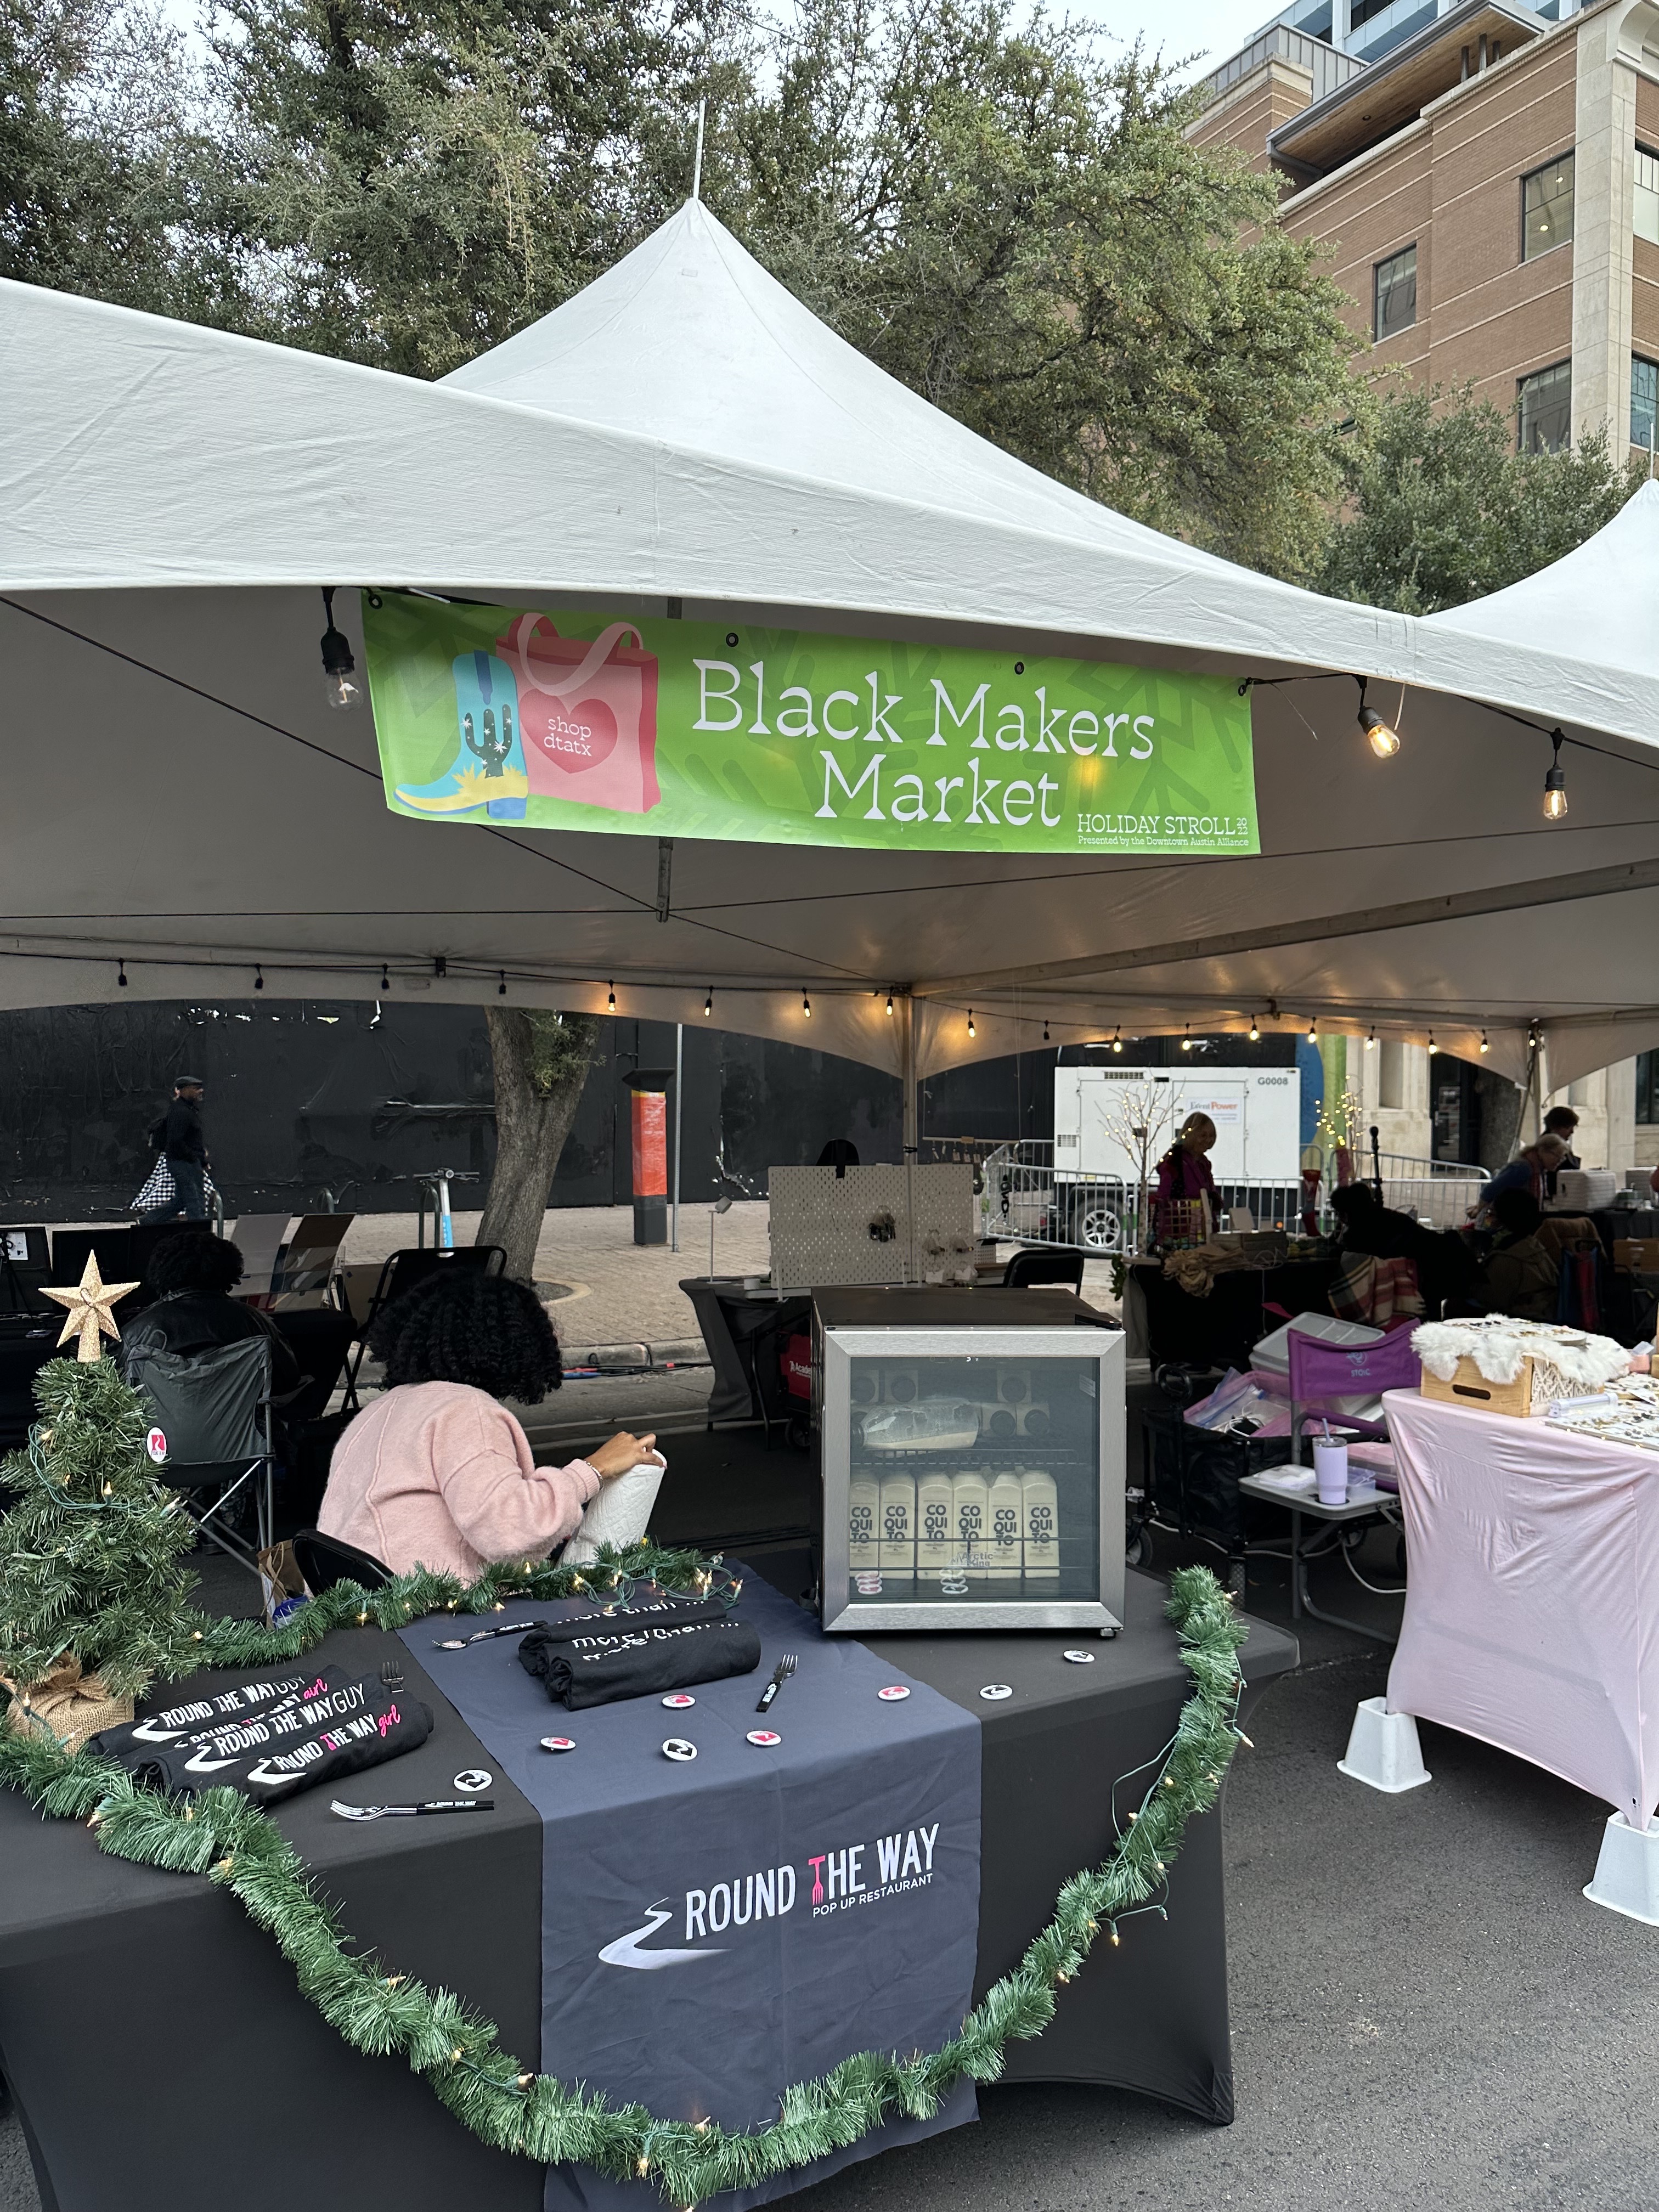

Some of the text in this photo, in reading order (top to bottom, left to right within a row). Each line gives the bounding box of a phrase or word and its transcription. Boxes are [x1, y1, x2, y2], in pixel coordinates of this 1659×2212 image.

[692, 658, 1154, 759] Black Makers
[548, 716, 591, 741] shop
[544, 733, 592, 757] dtatx
[814, 751, 1061, 827] Market
[1077, 814, 1235, 835] HOLIDAY STROLL
[1077, 836, 1249, 847] Presented by the Downtown Austin Alliance
[1257, 1077, 1288, 1085] G0008
[851, 1506, 871, 1518] CO
[886, 1505, 906, 1517] CO
[927, 1504, 946, 1515] CO
[961, 1505, 981, 1516] CO
[996, 1509, 1015, 1520] CO
[1031, 1507, 1051, 1518] CO
[850, 1519, 872, 1532] QUI
[884, 1518, 907, 1531] QUI
[924, 1516, 947, 1530] QUI
[959, 1517, 981, 1530] QUI
[994, 1521, 1017, 1534] QUI
[1029, 1519, 1052, 1532] QUI
[851, 1532, 870, 1543] TO
[887, 1532, 905, 1542] TO
[927, 1530, 945, 1540] TO
[961, 1531, 979, 1541] TO
[996, 1534, 1014, 1546] TO
[1032, 1532, 1050, 1544] TO
[962, 1551, 994, 1560] Arctic
[159, 1675, 306, 1728] ROUND THE WAY GUY
[213, 1683, 365, 1756] ROUND THE WAY GUY
[272, 1704, 401, 1770] ROUND THE WAY girl
[686, 1822, 940, 1940] ROUND THE WAY
[812, 1873, 933, 1918] POP UP RESTAURANT
